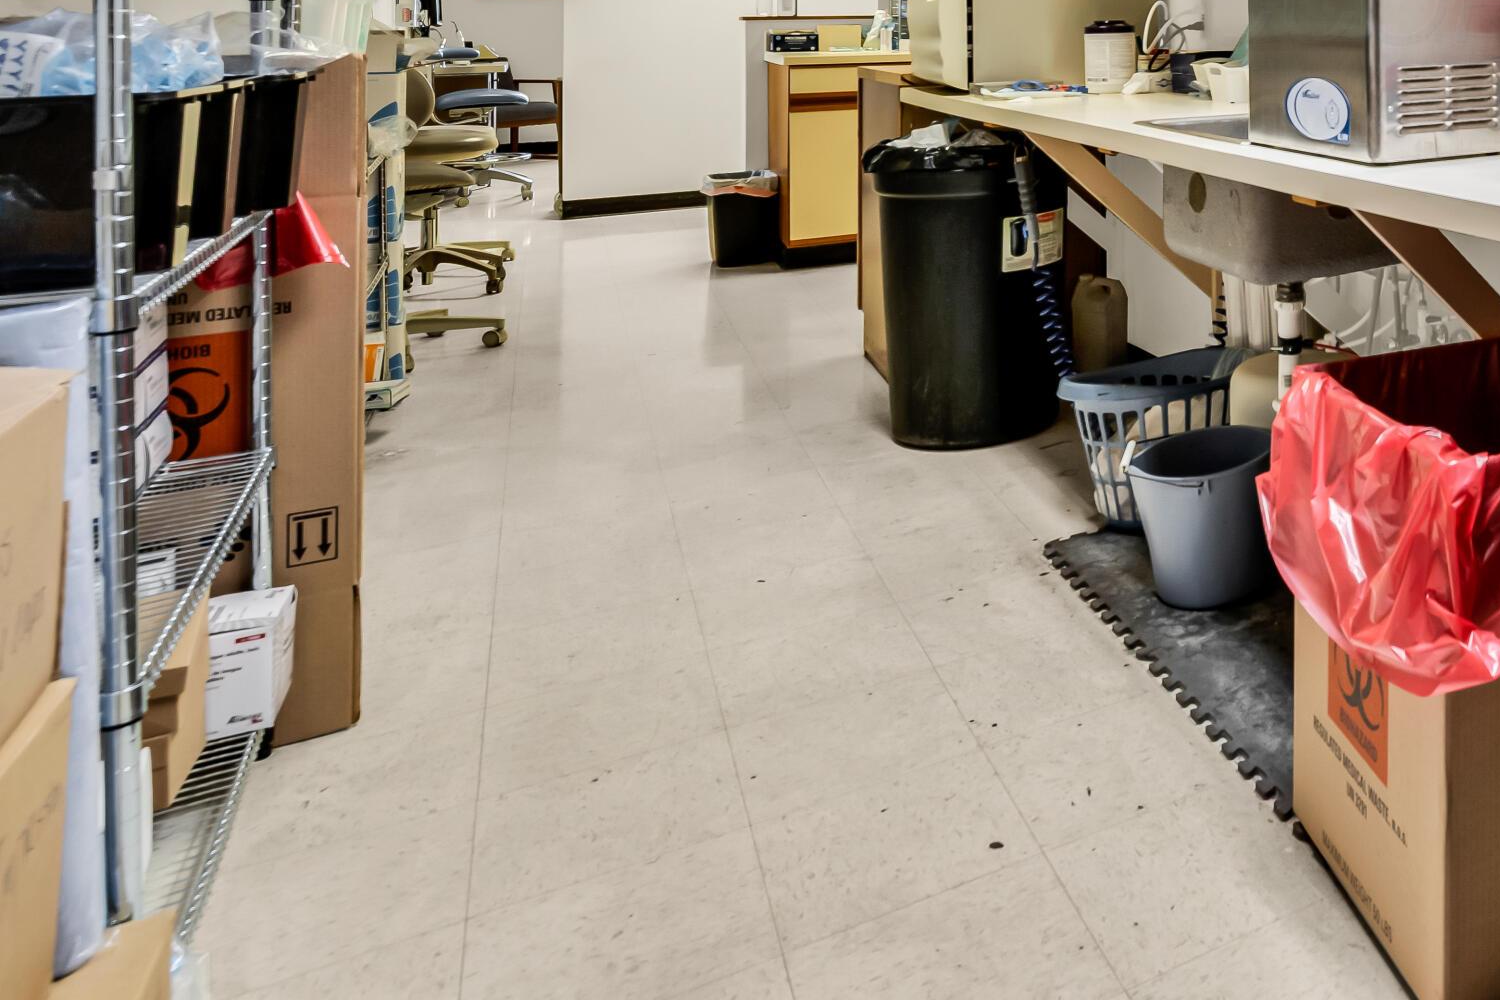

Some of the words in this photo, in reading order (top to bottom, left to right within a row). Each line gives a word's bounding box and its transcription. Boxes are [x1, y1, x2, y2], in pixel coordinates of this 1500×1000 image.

[206, 301, 292, 322] RELATED
[167, 343, 211, 360] BIOH
[1312, 714, 1342, 762] REGULATED
[1342, 754, 1367, 796] MEDICAL
